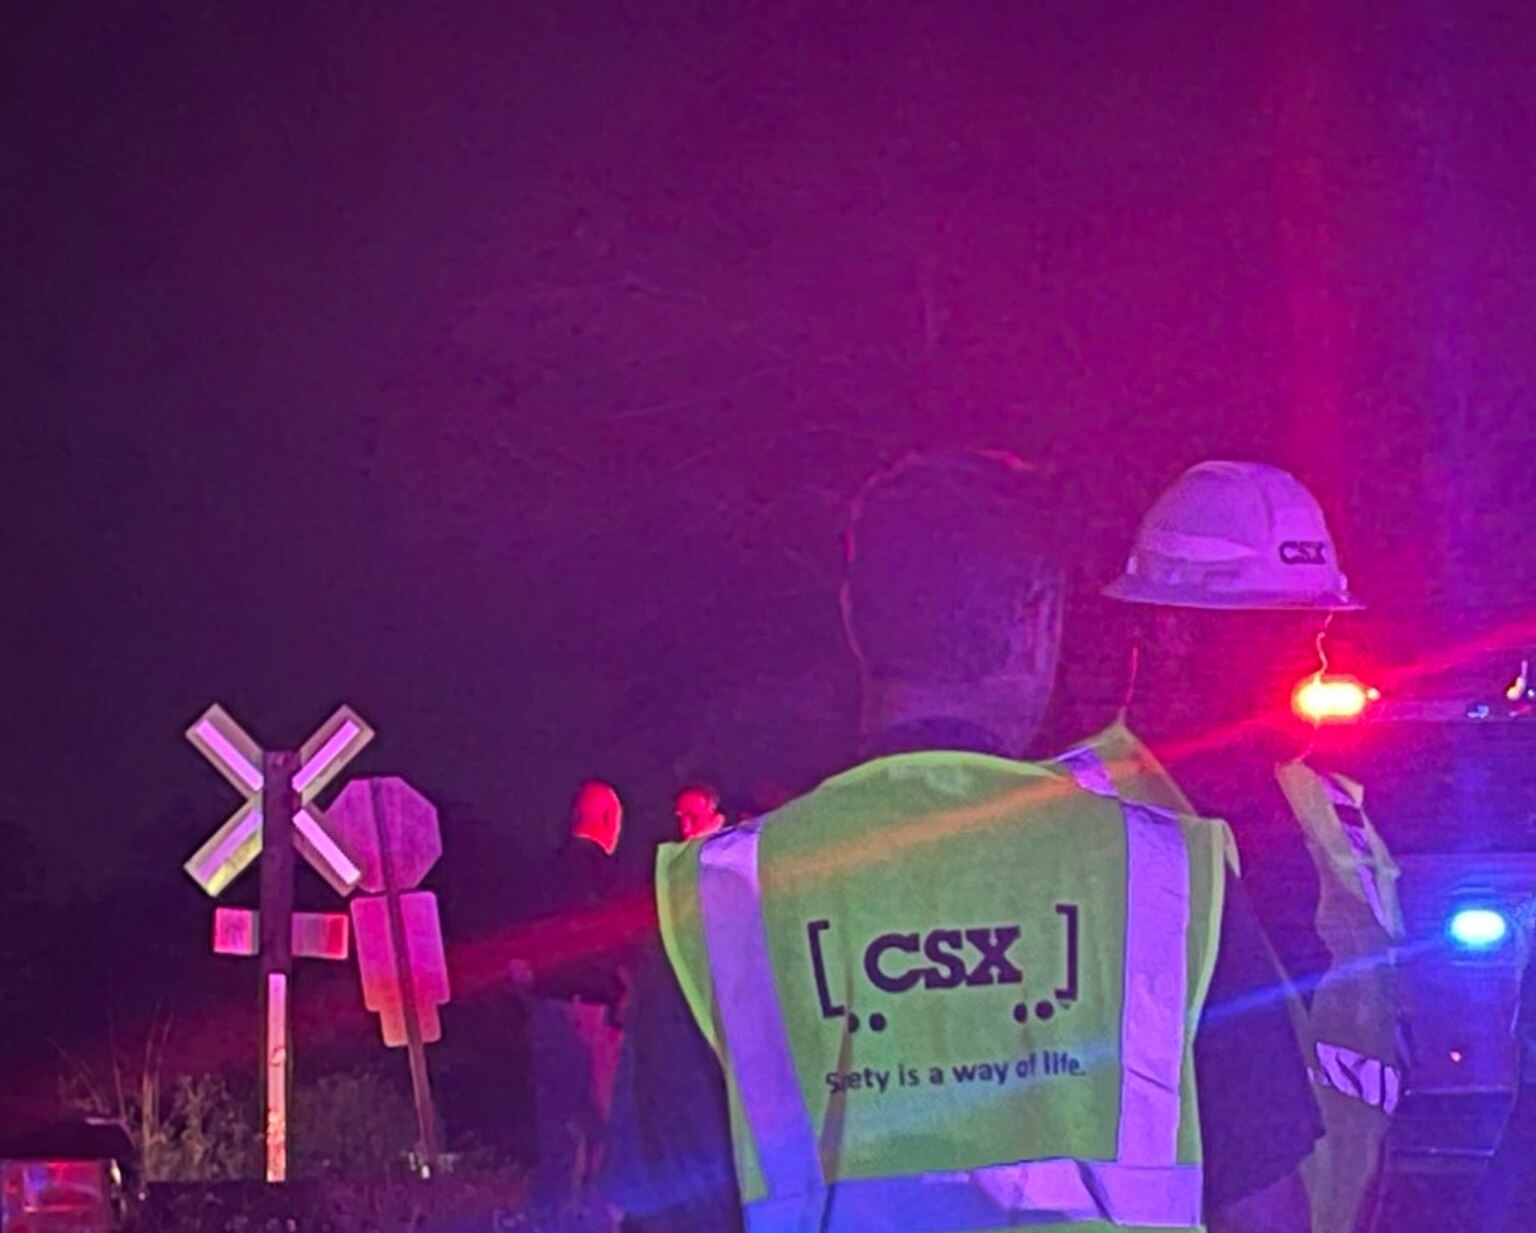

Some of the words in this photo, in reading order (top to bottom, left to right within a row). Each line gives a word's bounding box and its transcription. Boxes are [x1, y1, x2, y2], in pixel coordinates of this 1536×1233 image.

[1279, 541, 1326, 565] CSX
[864, 925, 1022, 993] CSX
[898, 1062, 920, 1087] is
[929, 1066, 944, 1086] a
[952, 1062, 1009, 1085] way
[1015, 1052, 1037, 1078] of
